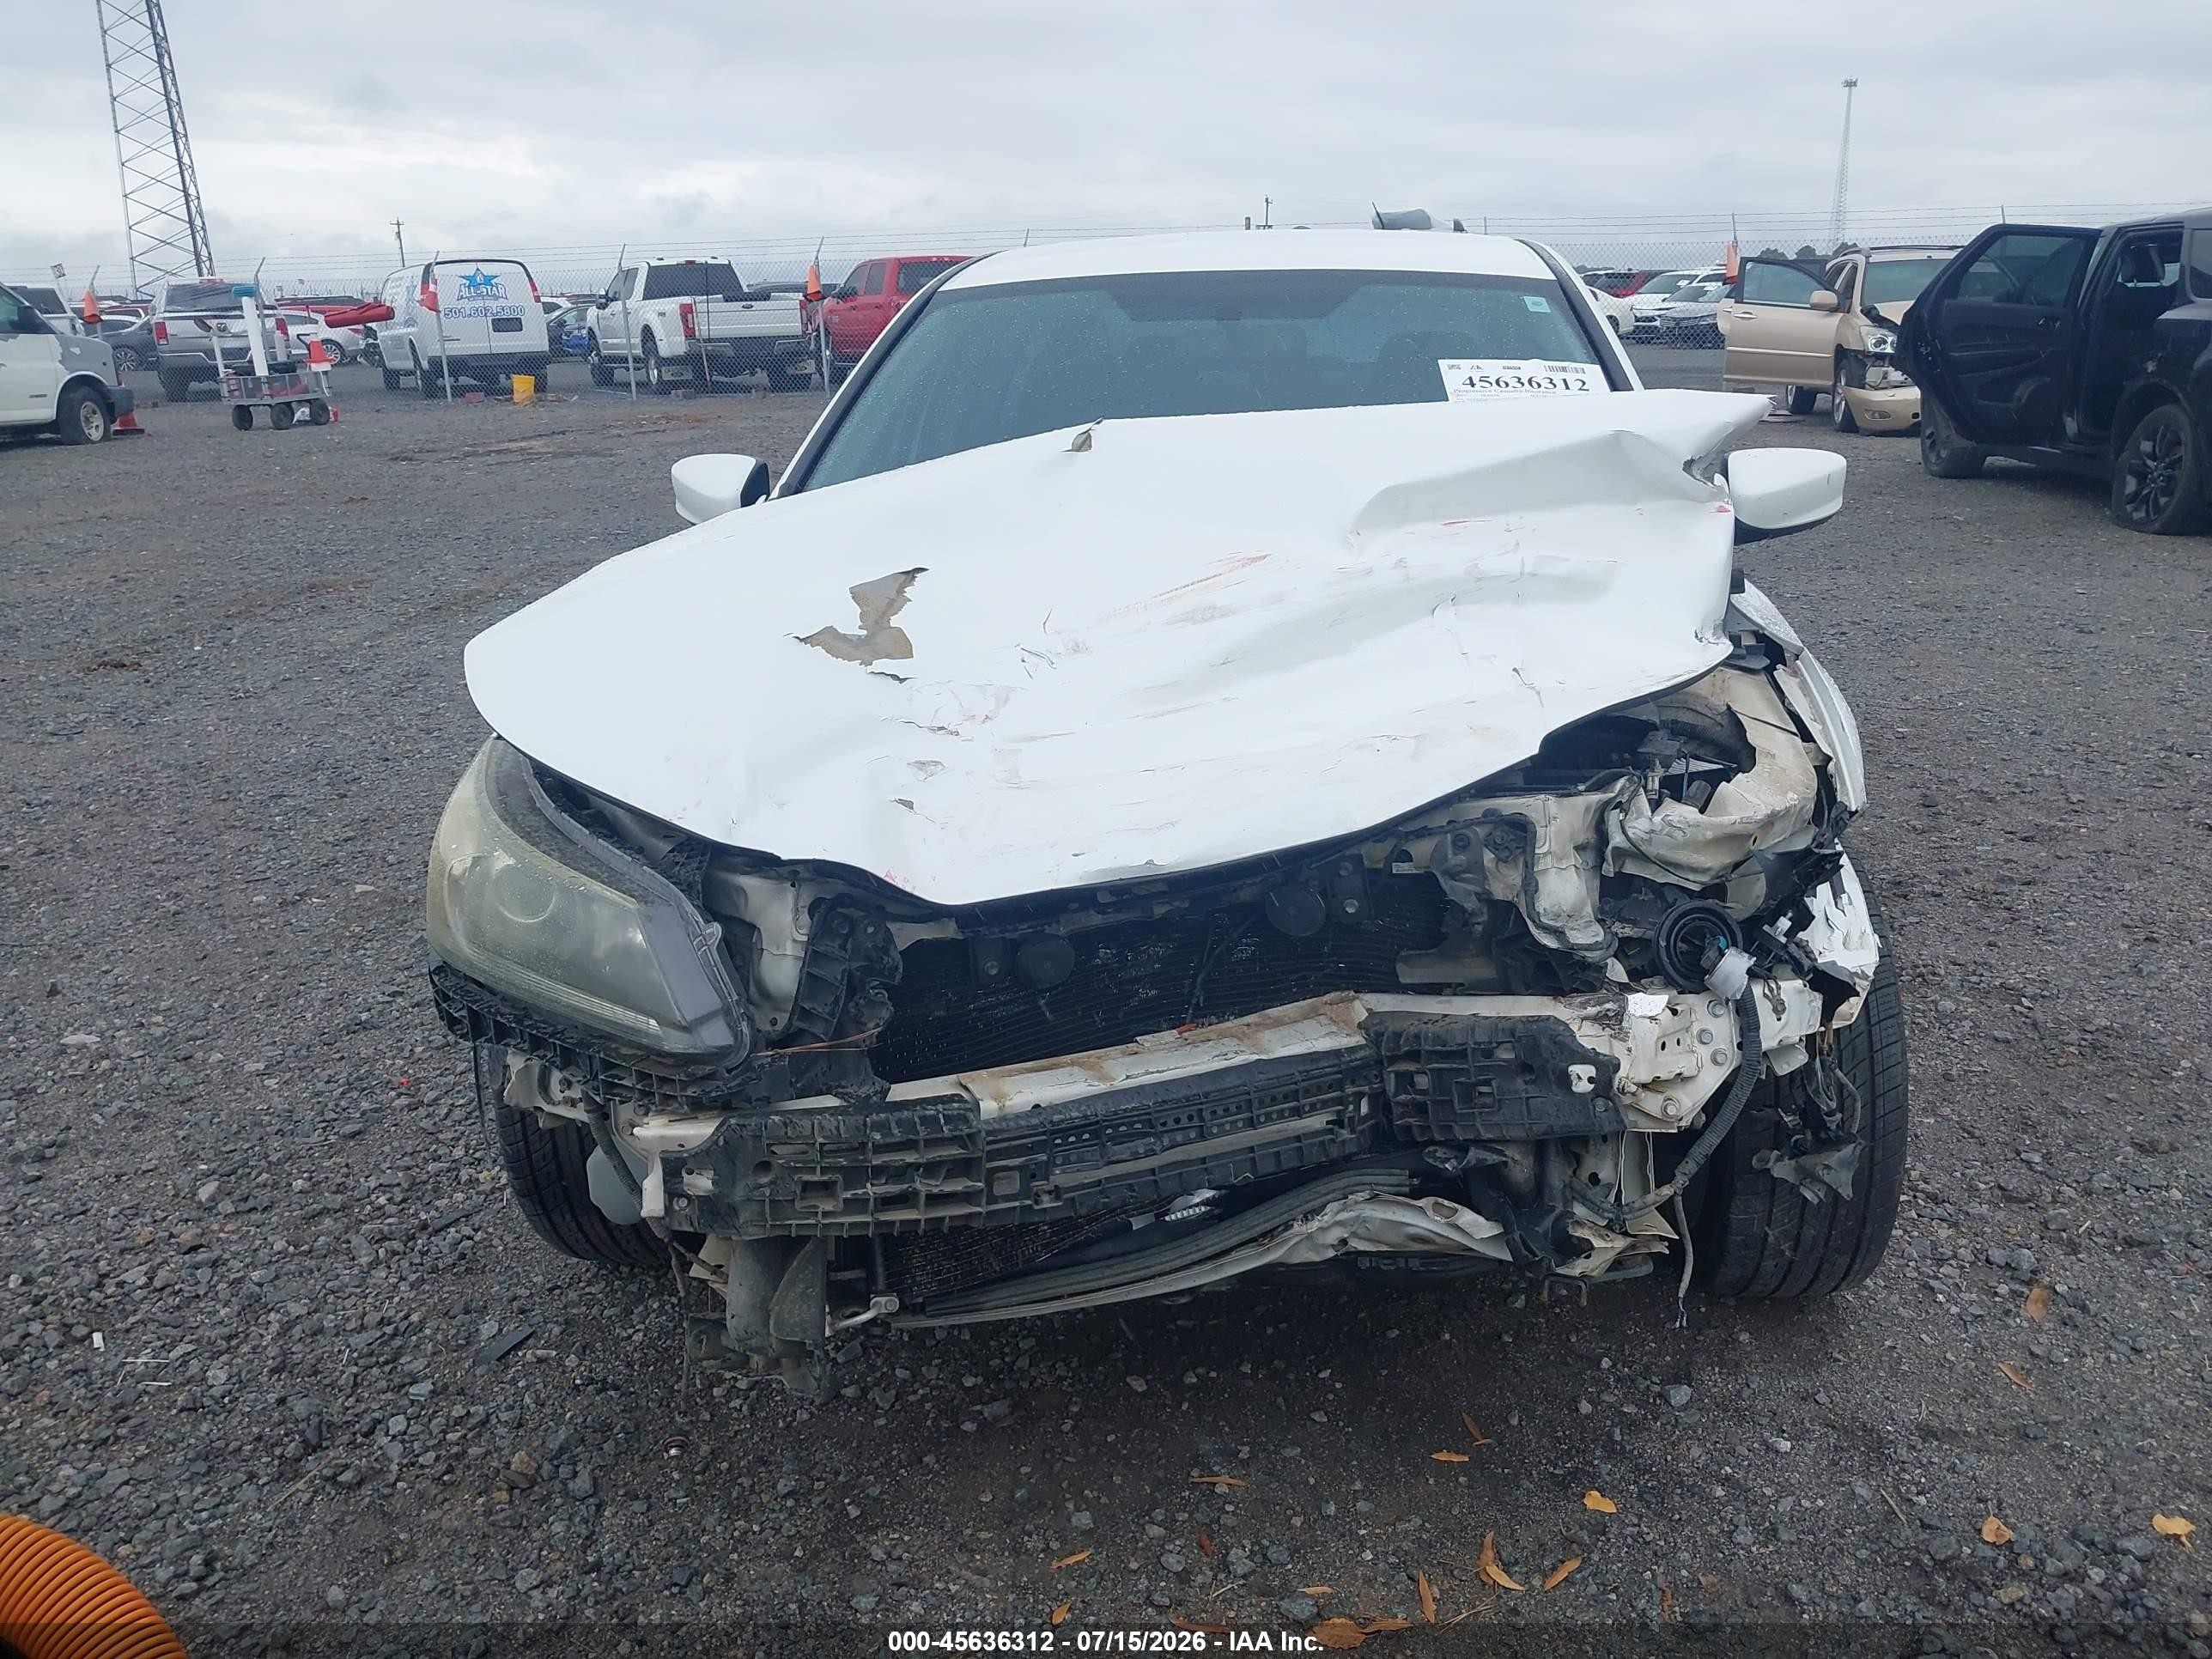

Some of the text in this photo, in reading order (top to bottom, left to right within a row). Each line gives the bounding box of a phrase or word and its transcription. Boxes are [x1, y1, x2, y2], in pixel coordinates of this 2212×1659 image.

[458, 283, 508, 301] ALL-STAR
[444, 305, 525, 319] 501.602.5800
[1462, 375, 1589, 392] 45636312
